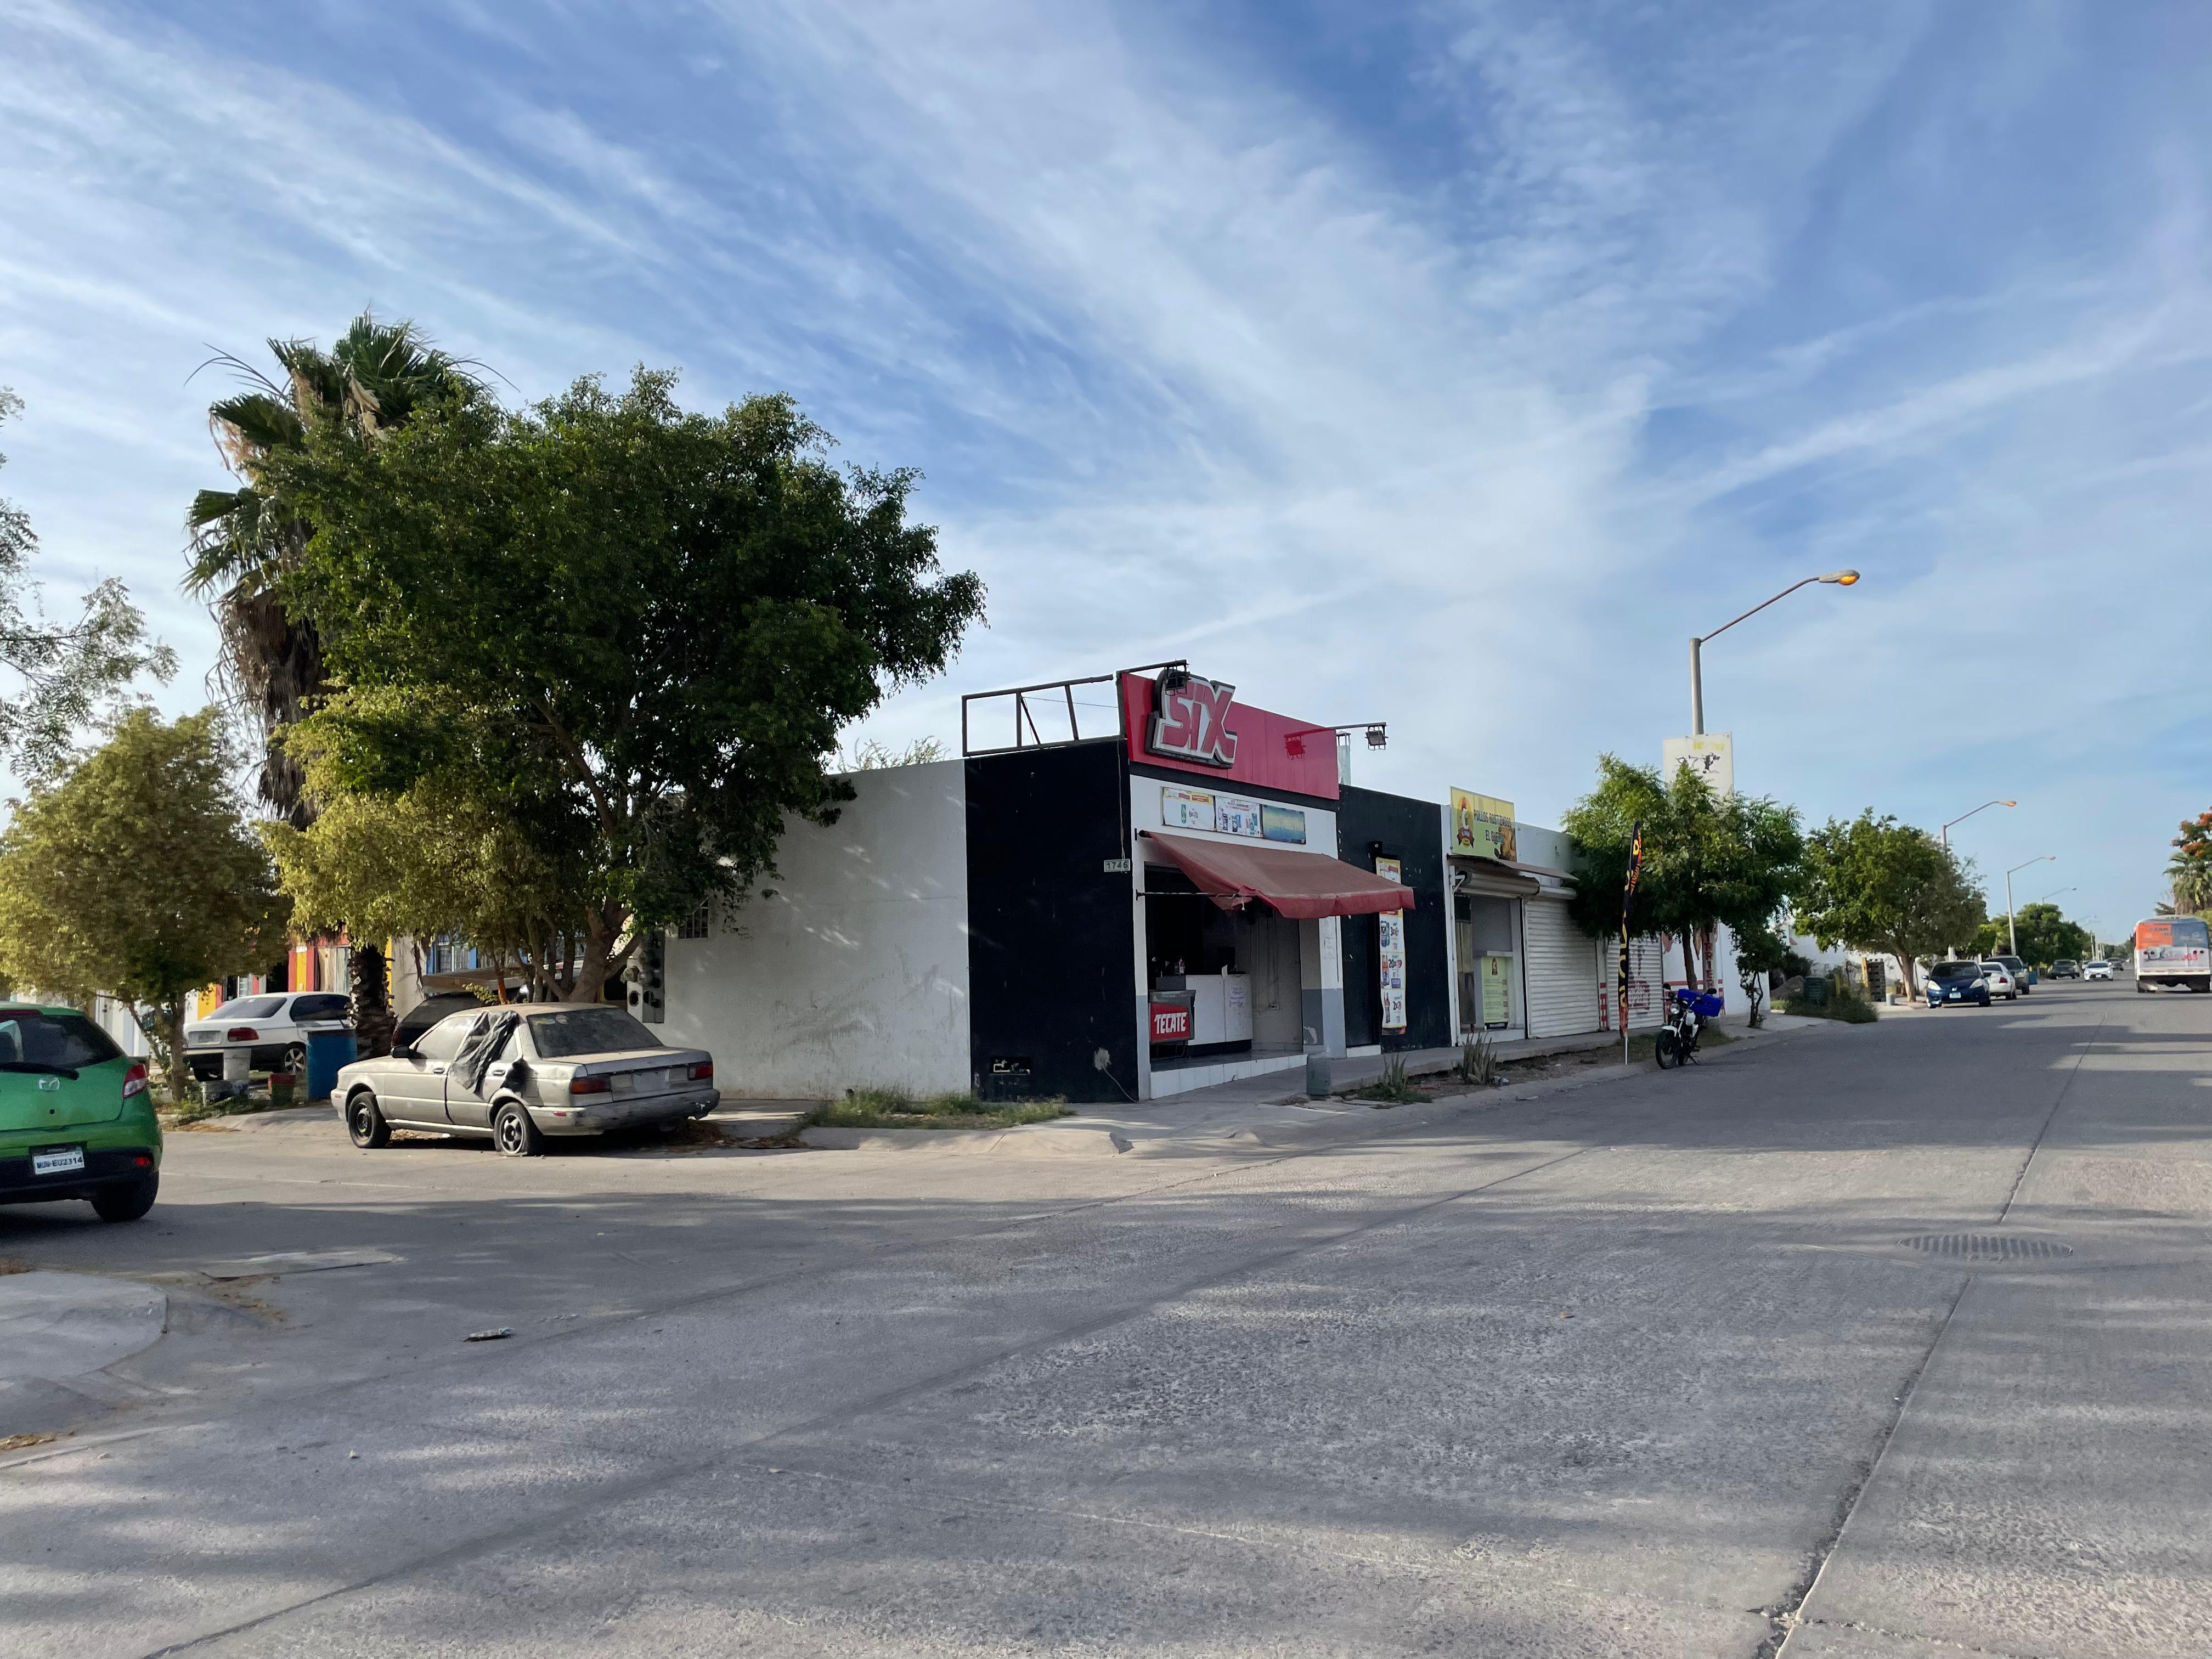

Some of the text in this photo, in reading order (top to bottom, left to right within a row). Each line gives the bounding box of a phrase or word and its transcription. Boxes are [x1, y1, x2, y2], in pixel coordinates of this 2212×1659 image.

[1156, 676, 1238, 763] SIX
[1106, 861, 1128, 870] 1746
[1154, 1012, 1188, 1034] TECATE
